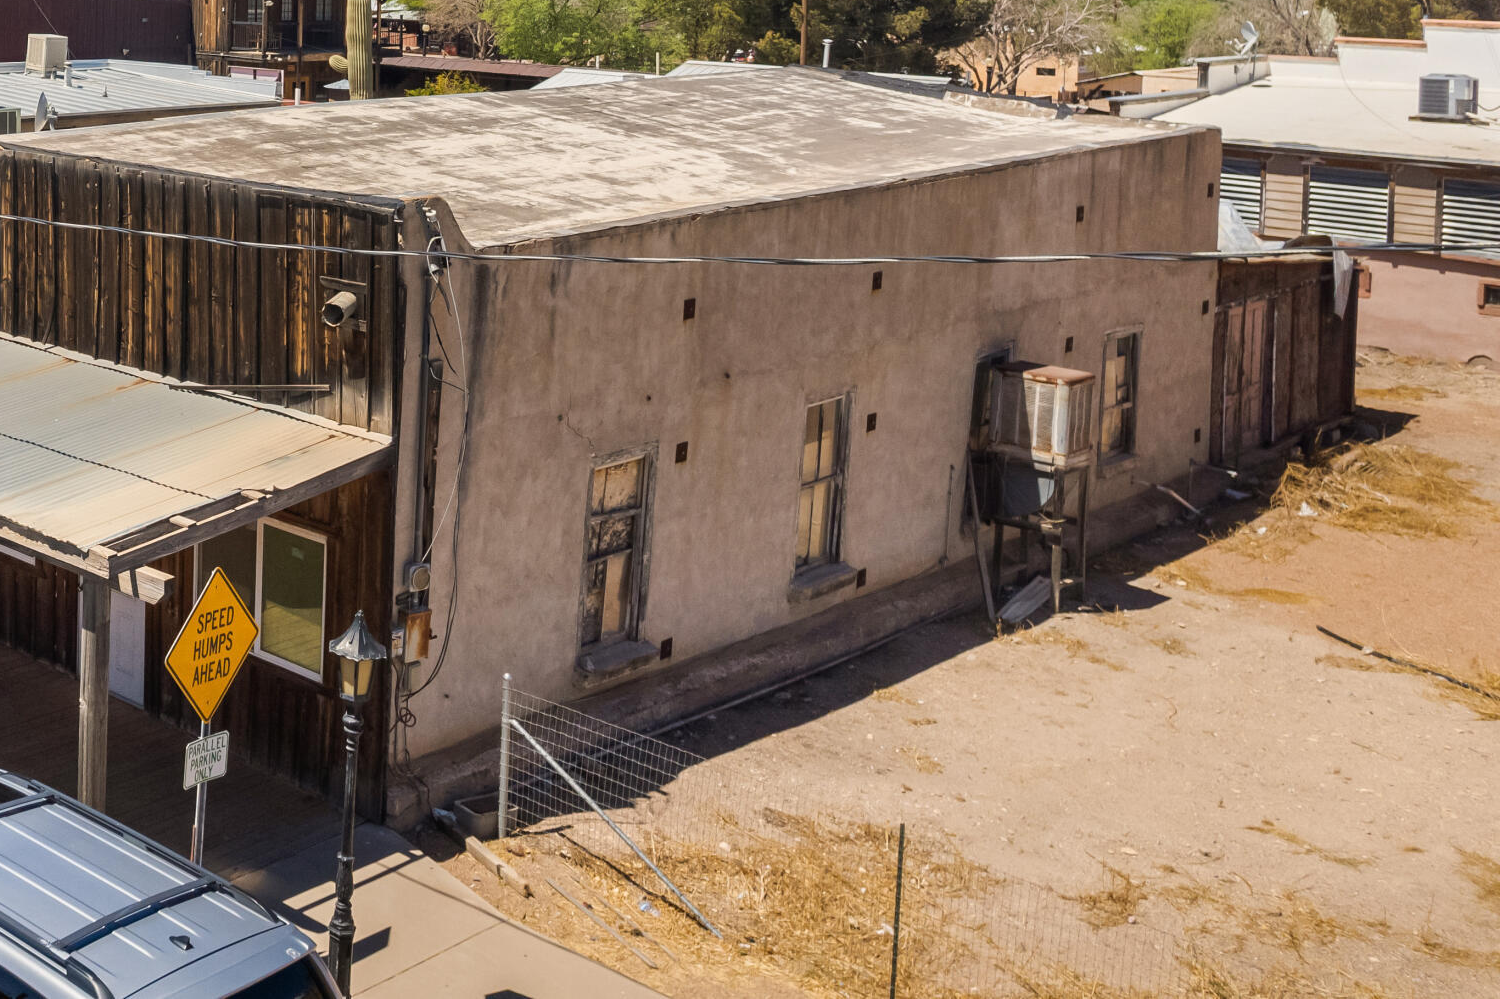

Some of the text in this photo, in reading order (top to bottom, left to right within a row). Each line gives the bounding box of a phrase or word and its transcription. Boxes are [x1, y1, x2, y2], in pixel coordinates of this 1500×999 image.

[197, 606, 234, 634] SPEED
[193, 631, 234, 661] HUMPS
[192, 657, 231, 688] AHEAD
[188, 736, 226, 759] PARALLEL
[190, 750, 222, 771] PARKING
[194, 765, 214, 782] ONLY
